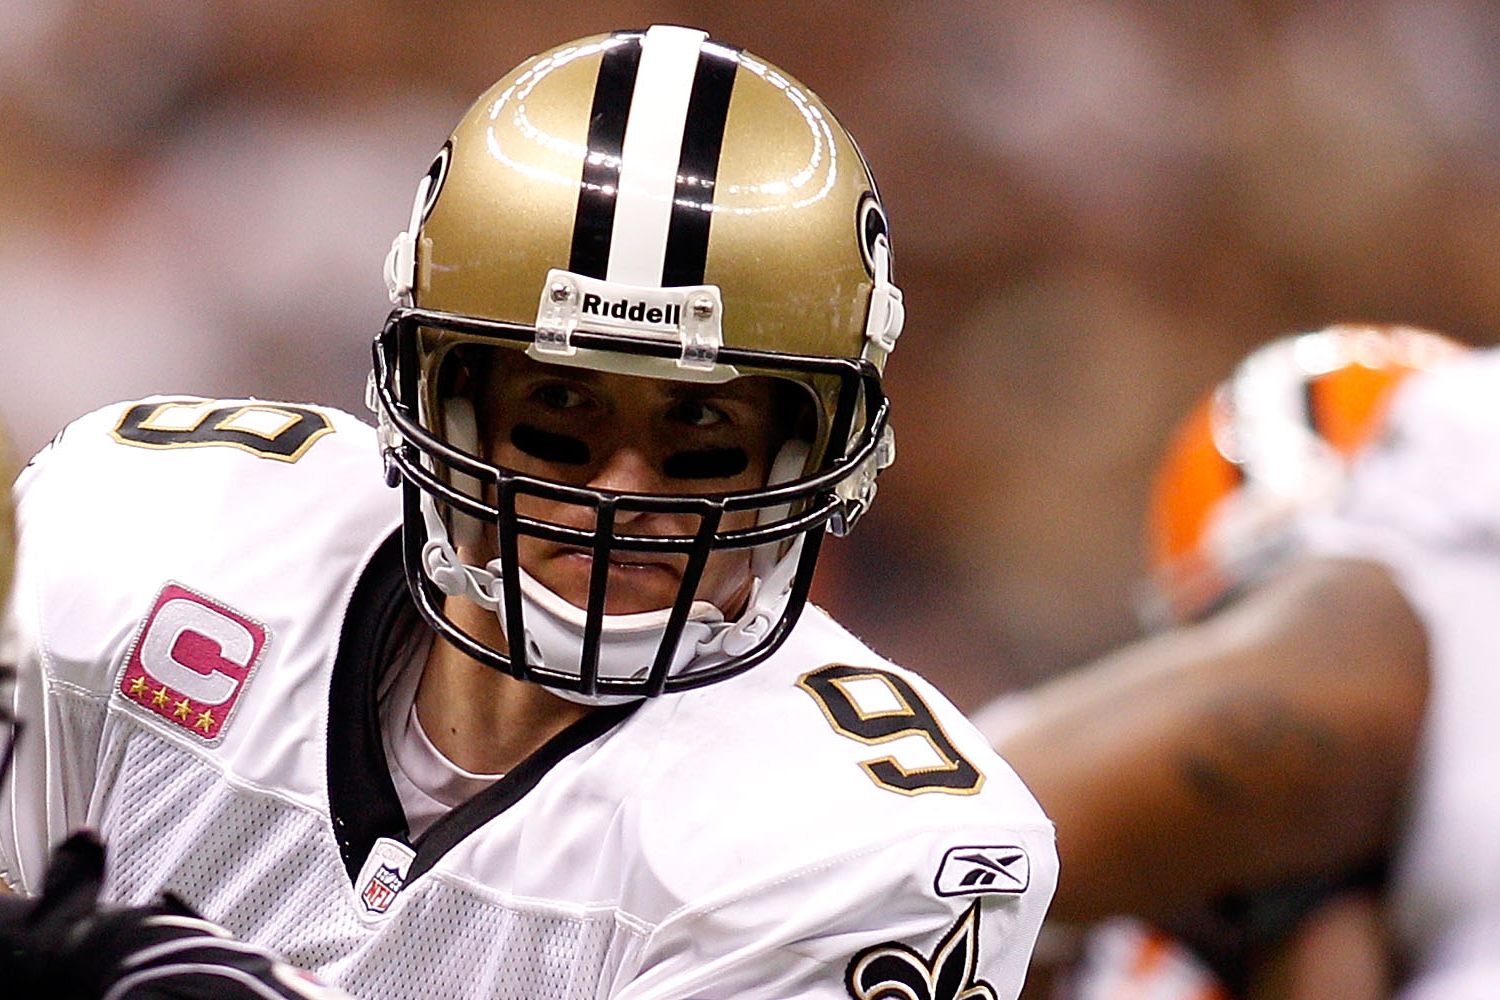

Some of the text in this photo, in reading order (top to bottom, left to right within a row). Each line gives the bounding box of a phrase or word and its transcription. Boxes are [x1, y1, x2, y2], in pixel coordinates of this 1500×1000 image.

[581, 293, 681, 326] Riddell
[140, 598, 254, 705] C
[796, 663, 986, 796] 9
[364, 879, 391, 909] NFL
